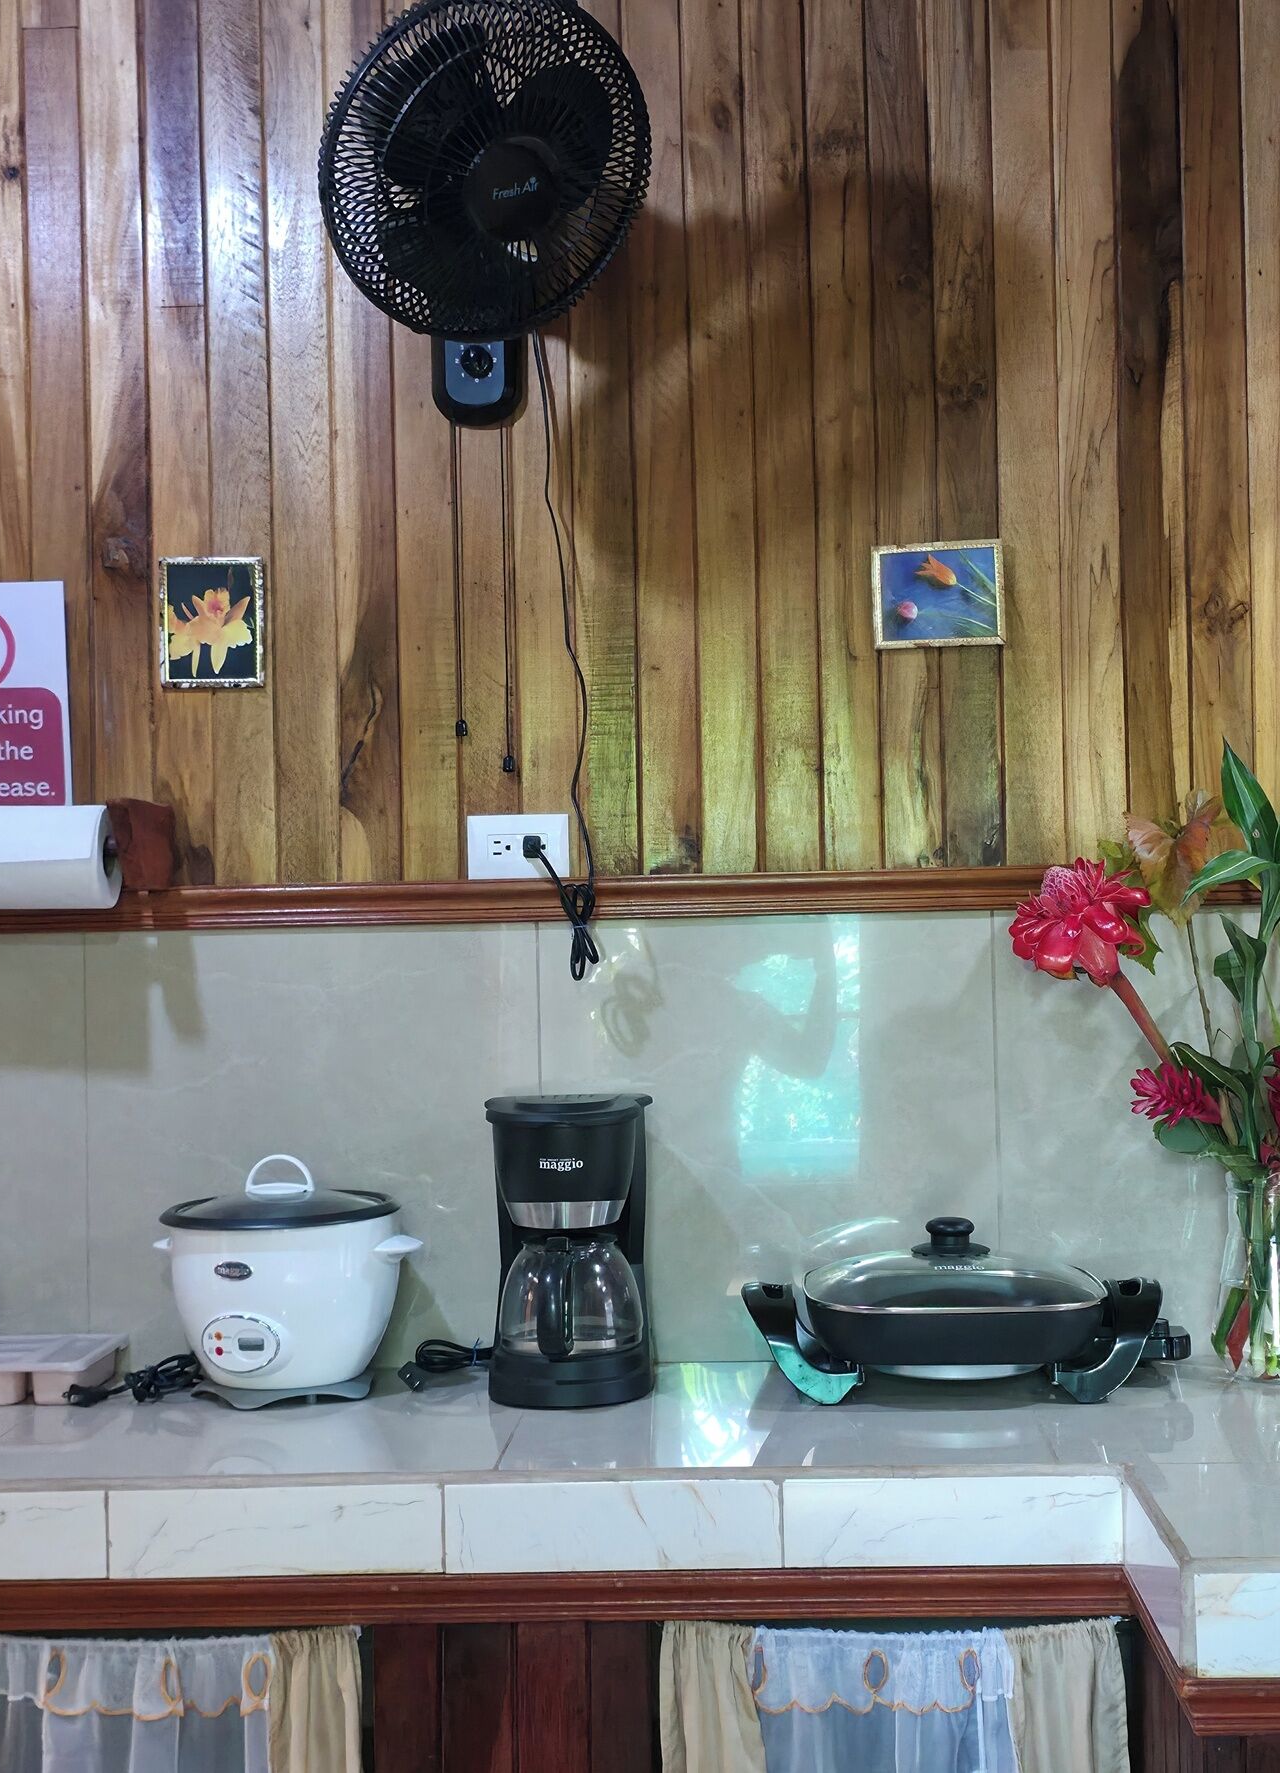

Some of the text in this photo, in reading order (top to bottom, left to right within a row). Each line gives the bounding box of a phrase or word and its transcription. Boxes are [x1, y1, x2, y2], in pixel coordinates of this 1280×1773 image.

[493, 176, 539, 200] Fresh Air
[539, 1158, 584, 1171] maggio
